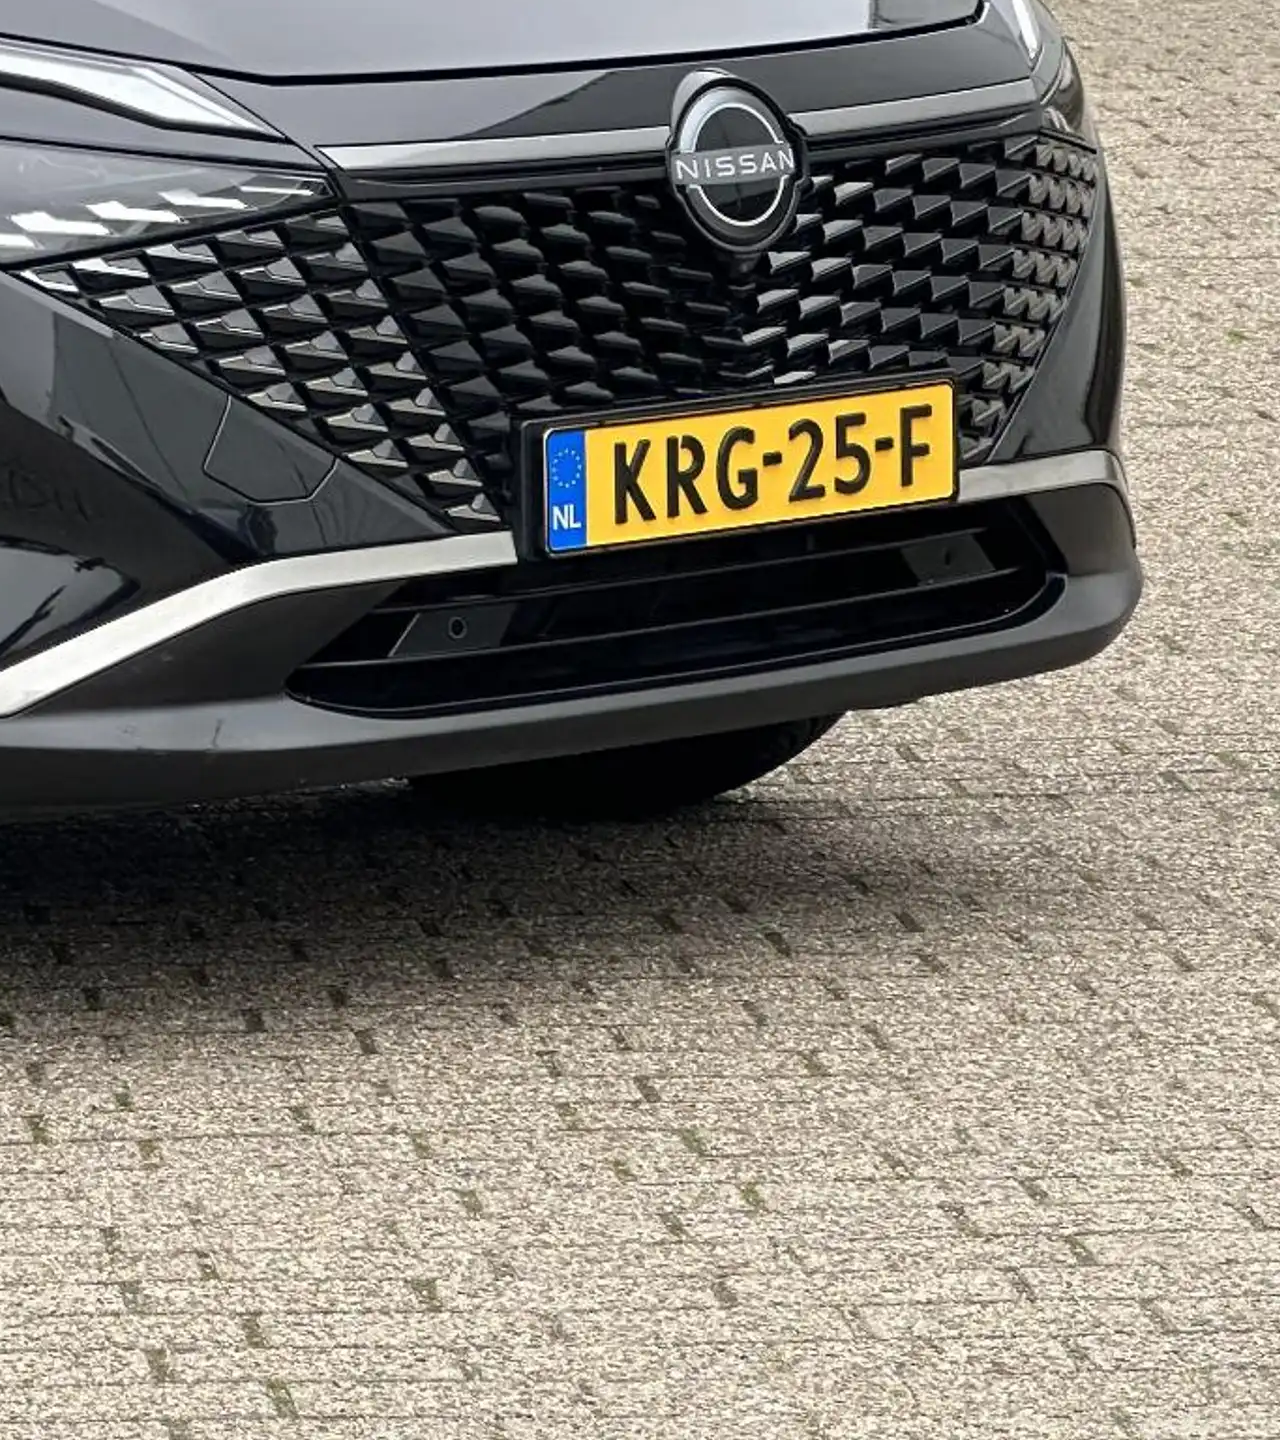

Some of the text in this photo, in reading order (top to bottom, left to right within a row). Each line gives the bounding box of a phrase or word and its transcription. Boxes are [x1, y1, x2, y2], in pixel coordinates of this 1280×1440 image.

[675, 147, 795, 180] NISSAN
[614, 404, 932, 524] KRG-25-F
[553, 505, 581, 531] NL
